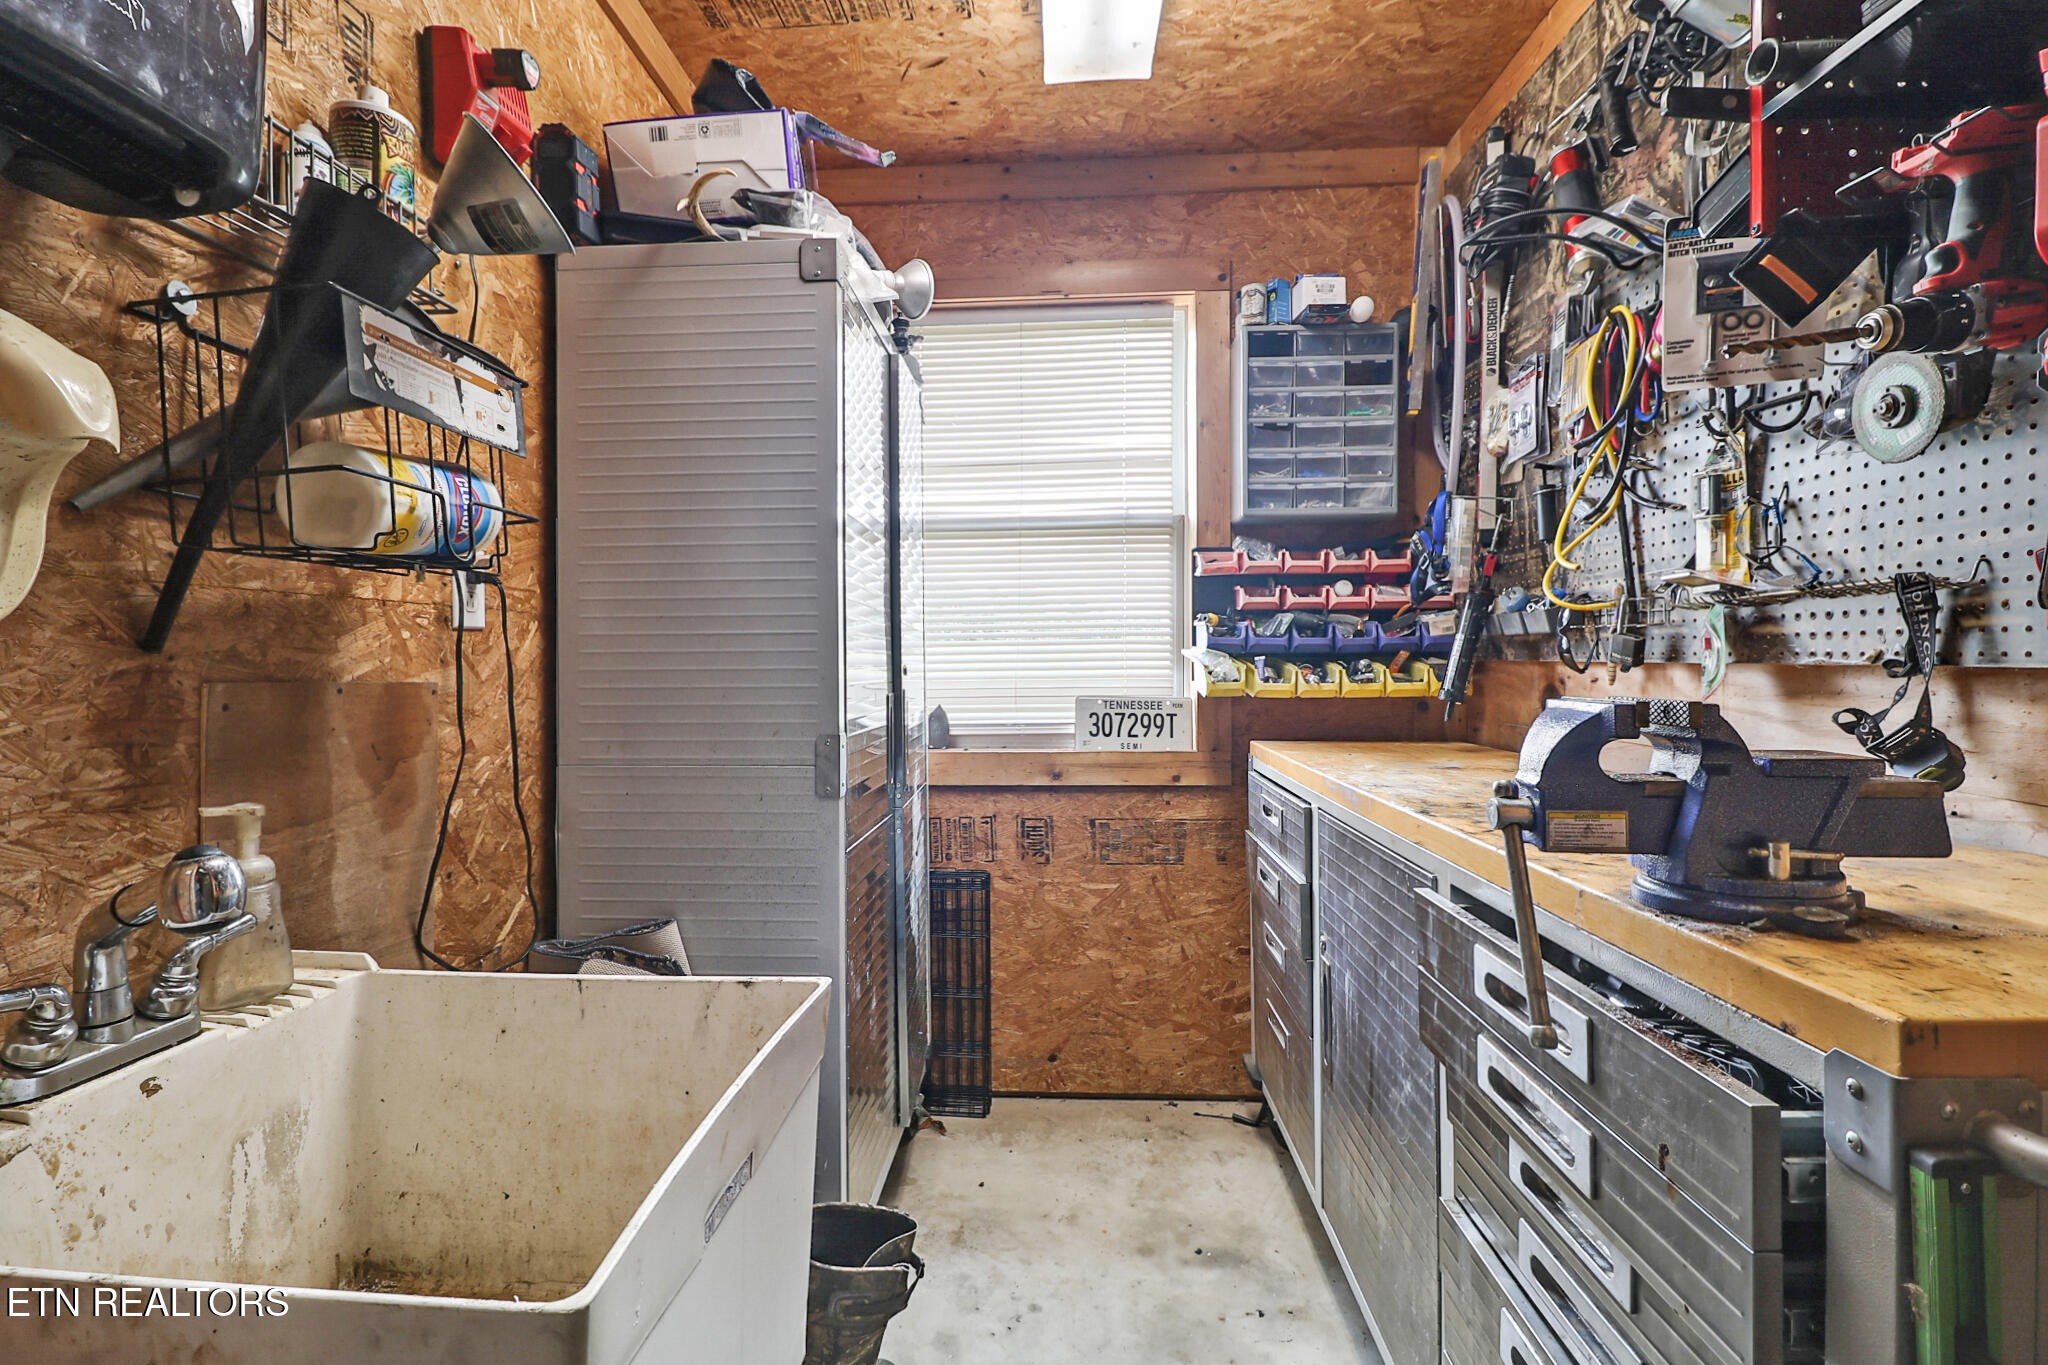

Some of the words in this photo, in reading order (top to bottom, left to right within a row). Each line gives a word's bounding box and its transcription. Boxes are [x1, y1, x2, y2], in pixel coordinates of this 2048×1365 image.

[1668, 249, 1690, 258] HITCH
[1691, 242, 1734, 254] TIGHTENER
[1486, 297, 1499, 368] BLACK&DECKER
[1103, 700, 1163, 711] TENNESSEE
[1088, 712, 1178, 739] 307299T
[1120, 742, 1143, 750] SEMI
